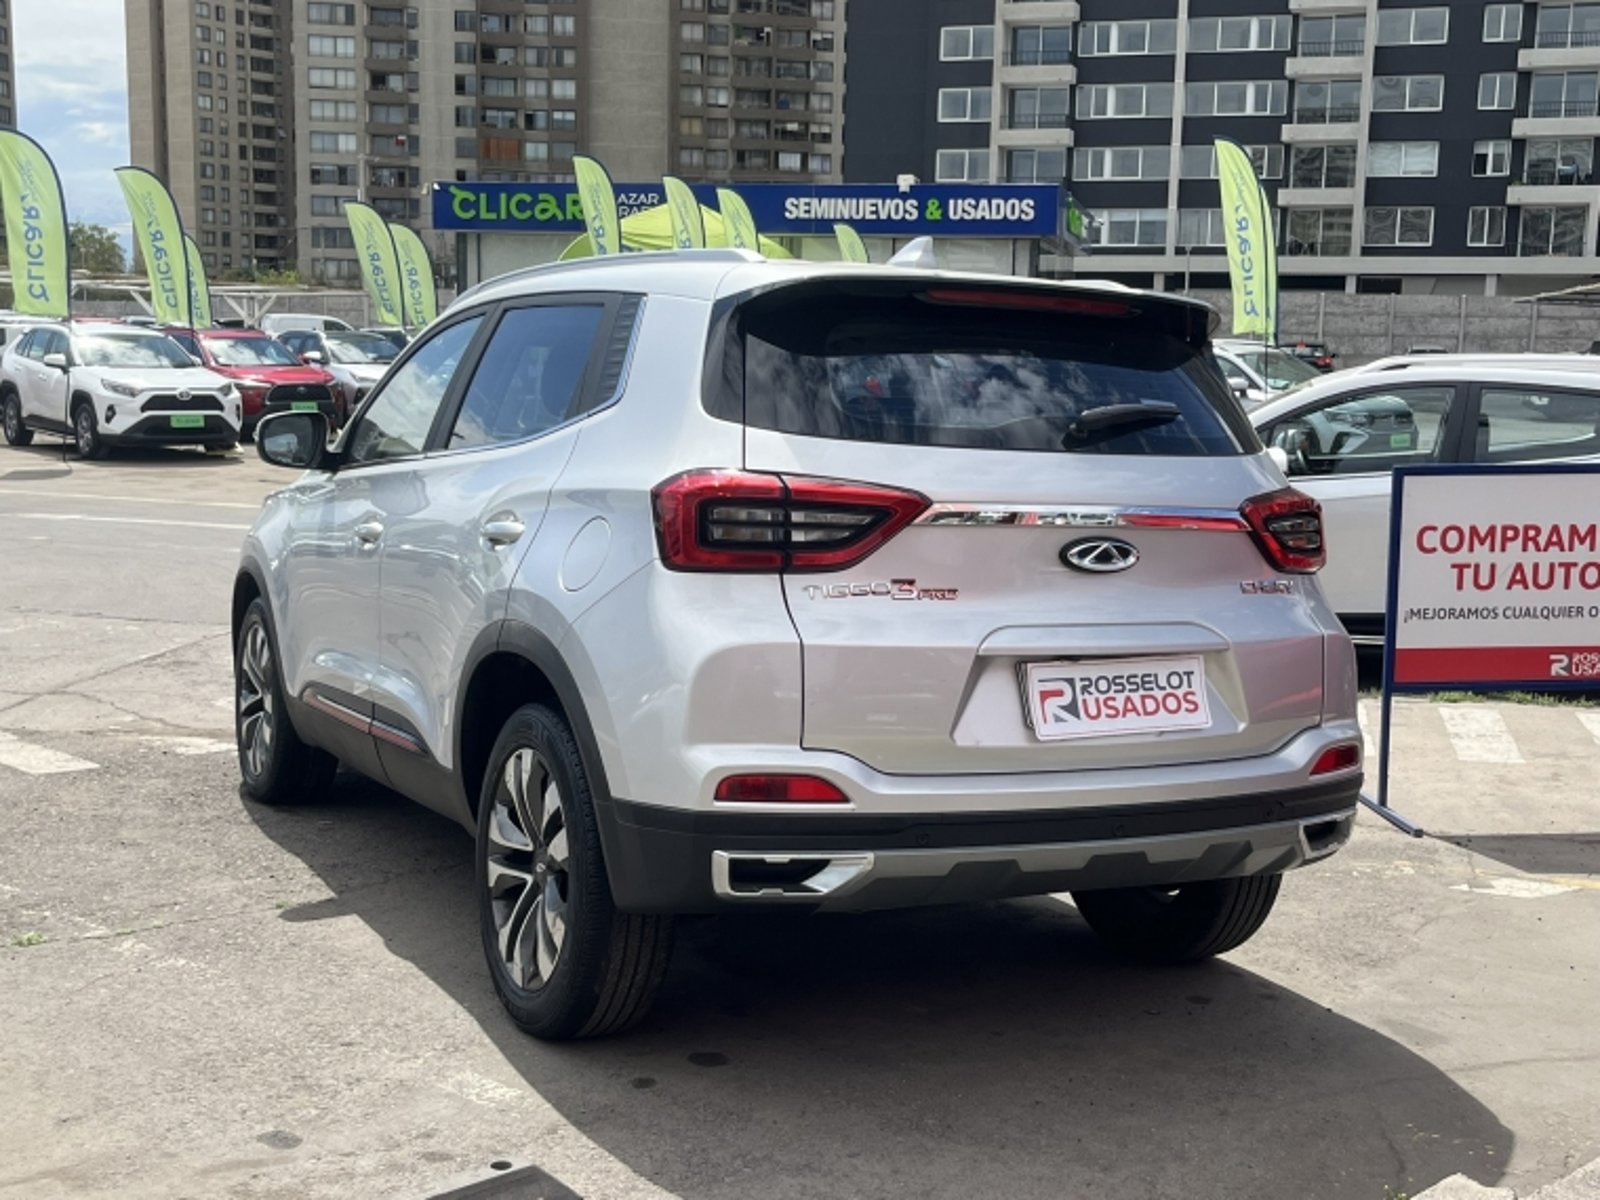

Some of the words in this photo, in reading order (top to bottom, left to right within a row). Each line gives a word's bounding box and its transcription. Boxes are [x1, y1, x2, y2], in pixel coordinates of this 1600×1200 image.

[784, 199, 918, 221] SEMINUEVOS
[925, 198, 943, 221] &
[949, 198, 1035, 221] USADOS
[1416, 524, 1597, 554] COMPRAM
[1450, 562, 1496, 591] TU
[1506, 562, 1600, 591] AUTO
[1404, 606, 1499, 623] ¡MEJORAMOS
[1502, 606, 1585, 621] CUALQUIER
[1079, 671, 1195, 695] ROSSELOT
[1079, 692, 1199, 721] USADOS
